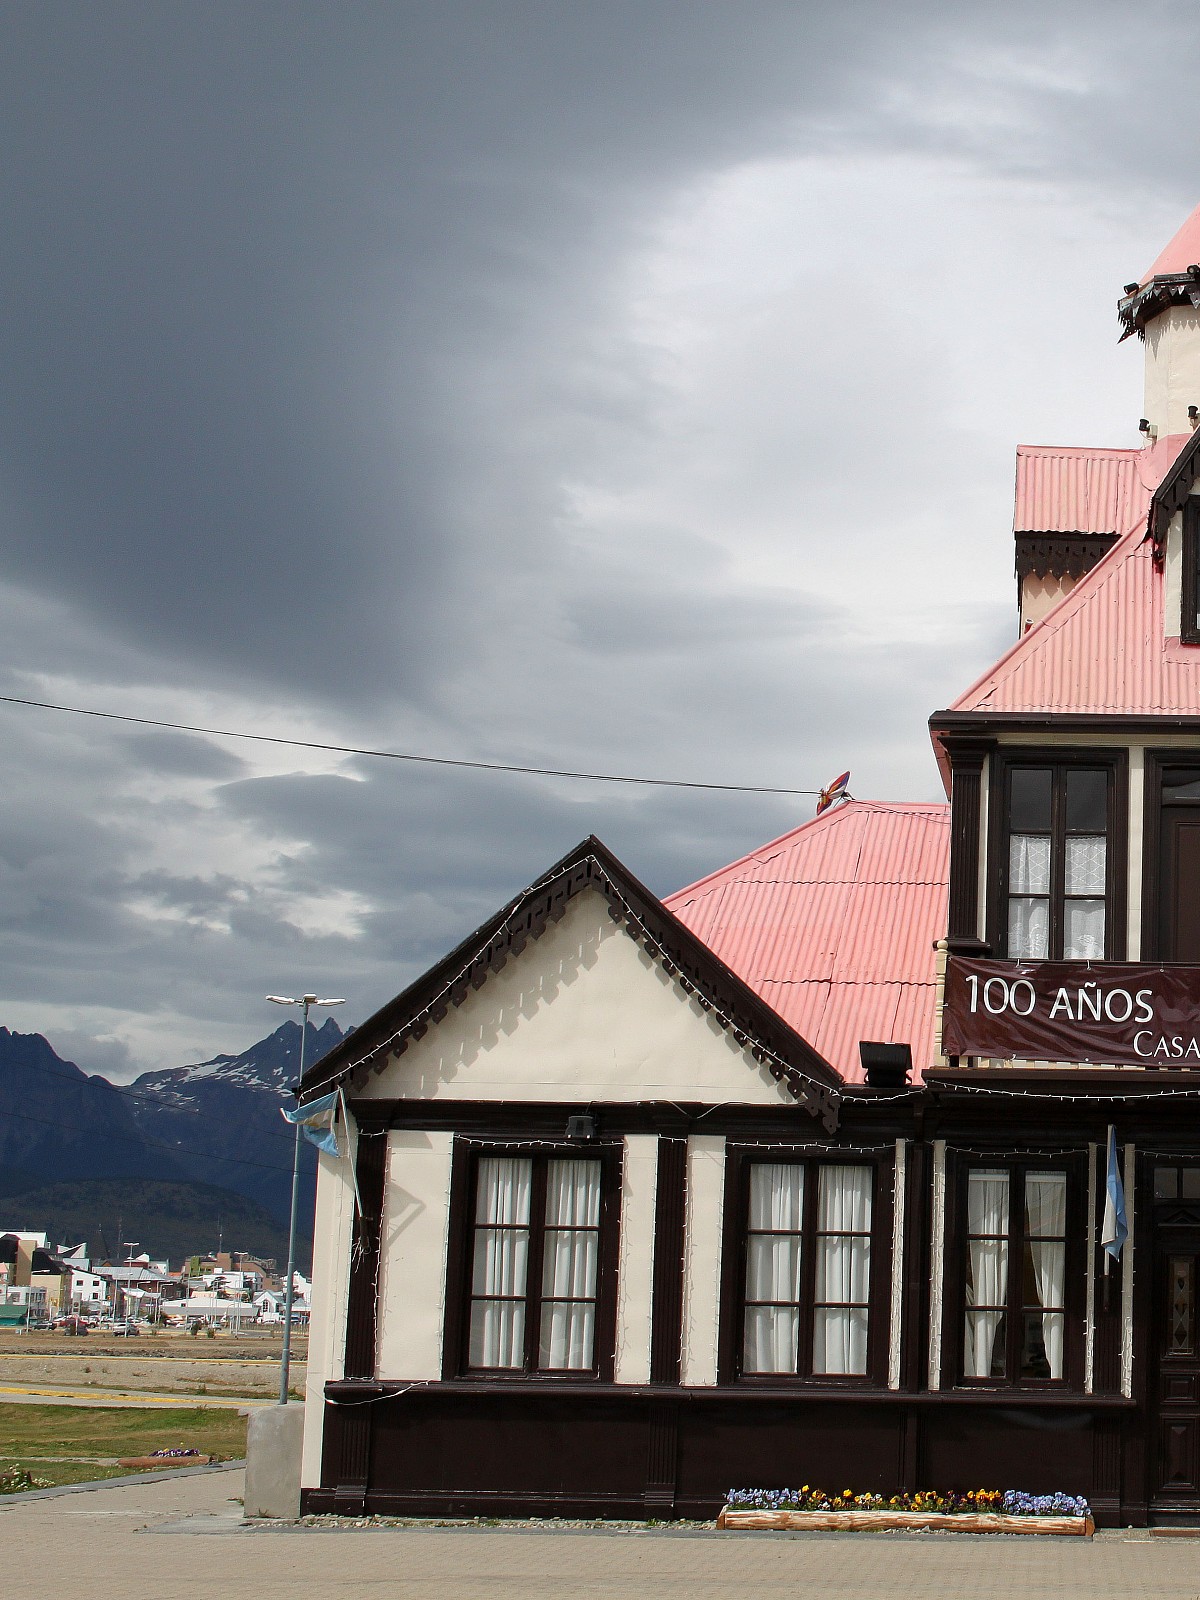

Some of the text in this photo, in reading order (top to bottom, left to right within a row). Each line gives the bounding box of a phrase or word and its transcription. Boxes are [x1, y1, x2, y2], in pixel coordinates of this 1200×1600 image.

[965, 974, 1154, 1023] 100 AÑOS
[1133, 1030, 1200, 1059] CASA
